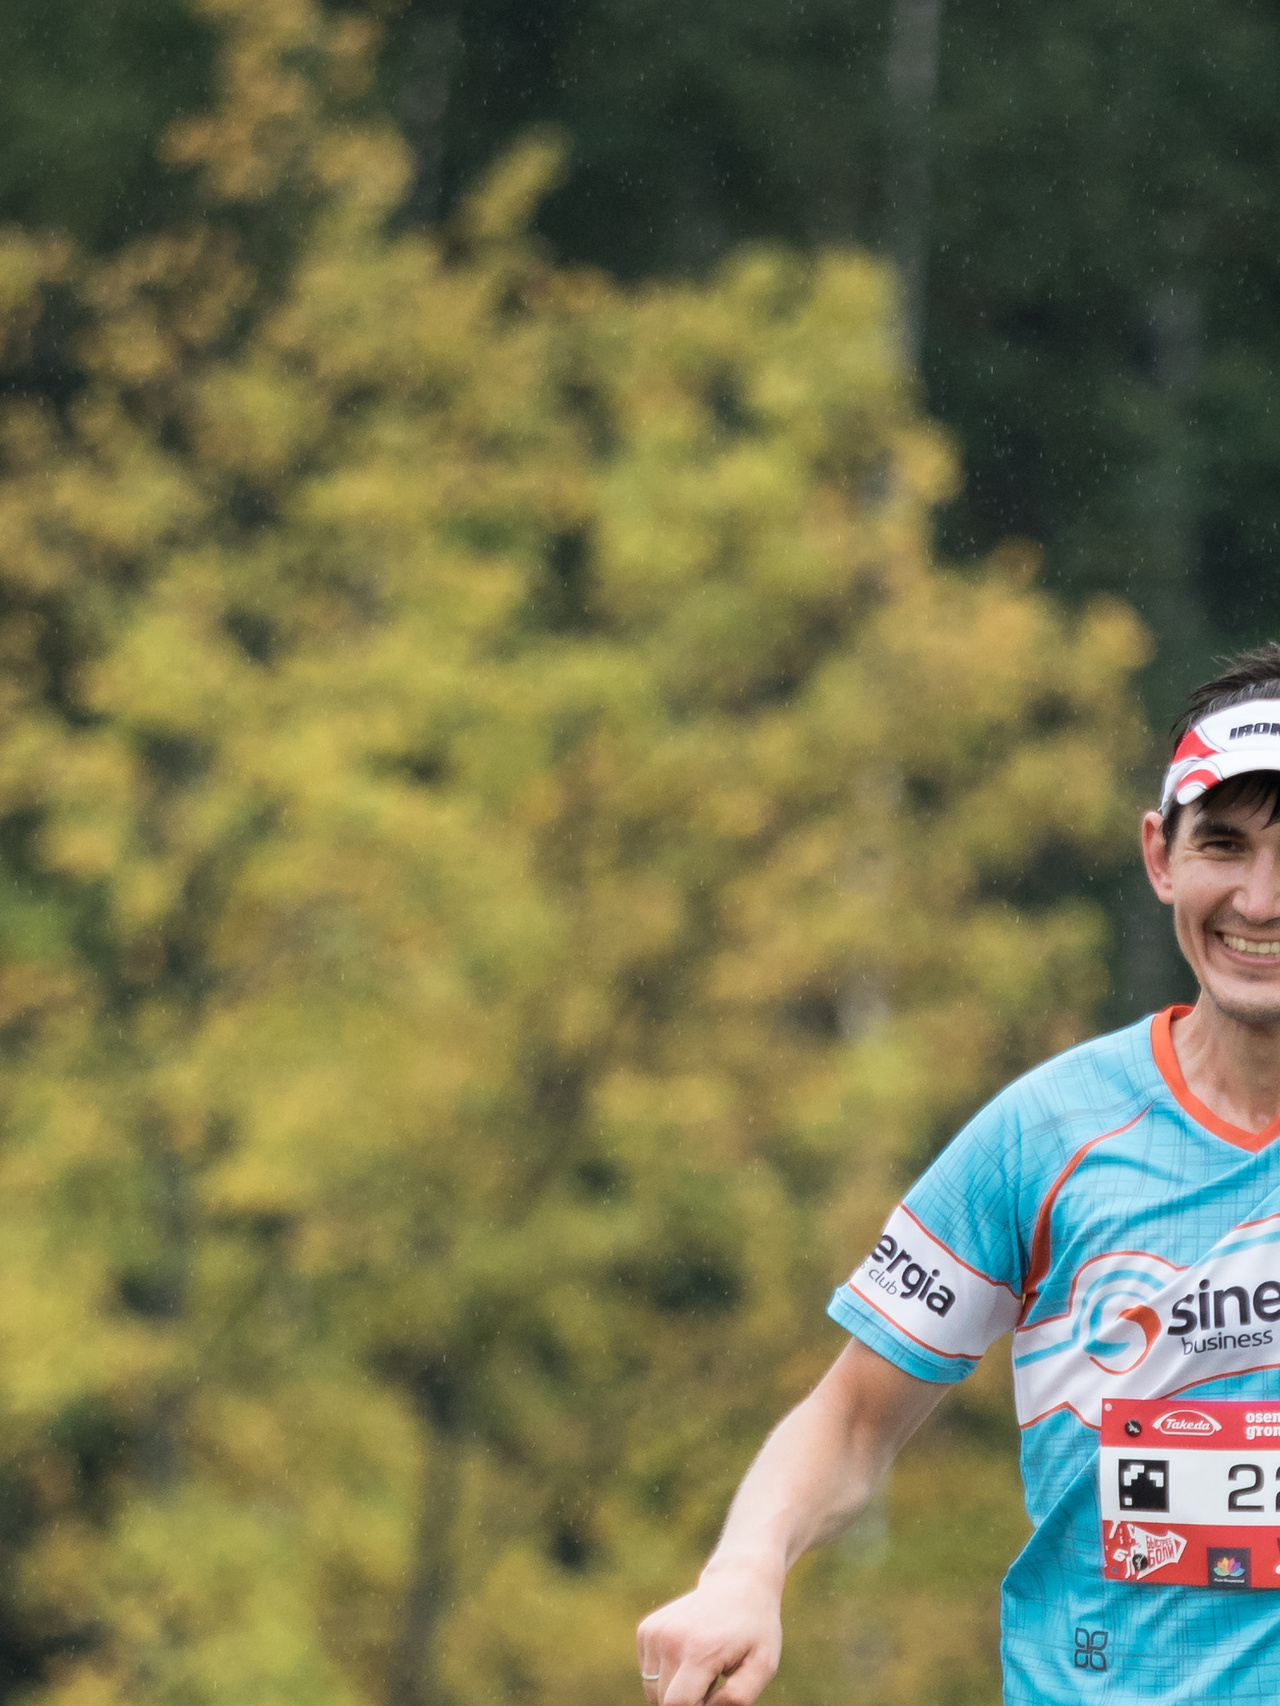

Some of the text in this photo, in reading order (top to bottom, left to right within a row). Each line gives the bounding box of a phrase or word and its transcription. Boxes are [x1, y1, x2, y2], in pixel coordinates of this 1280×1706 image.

[868, 1268, 898, 1295] club
[871, 1234, 956, 1318] ergia
[1182, 1324, 1273, 1355] business
[1165, 1418, 1211, 1431] Takeda
